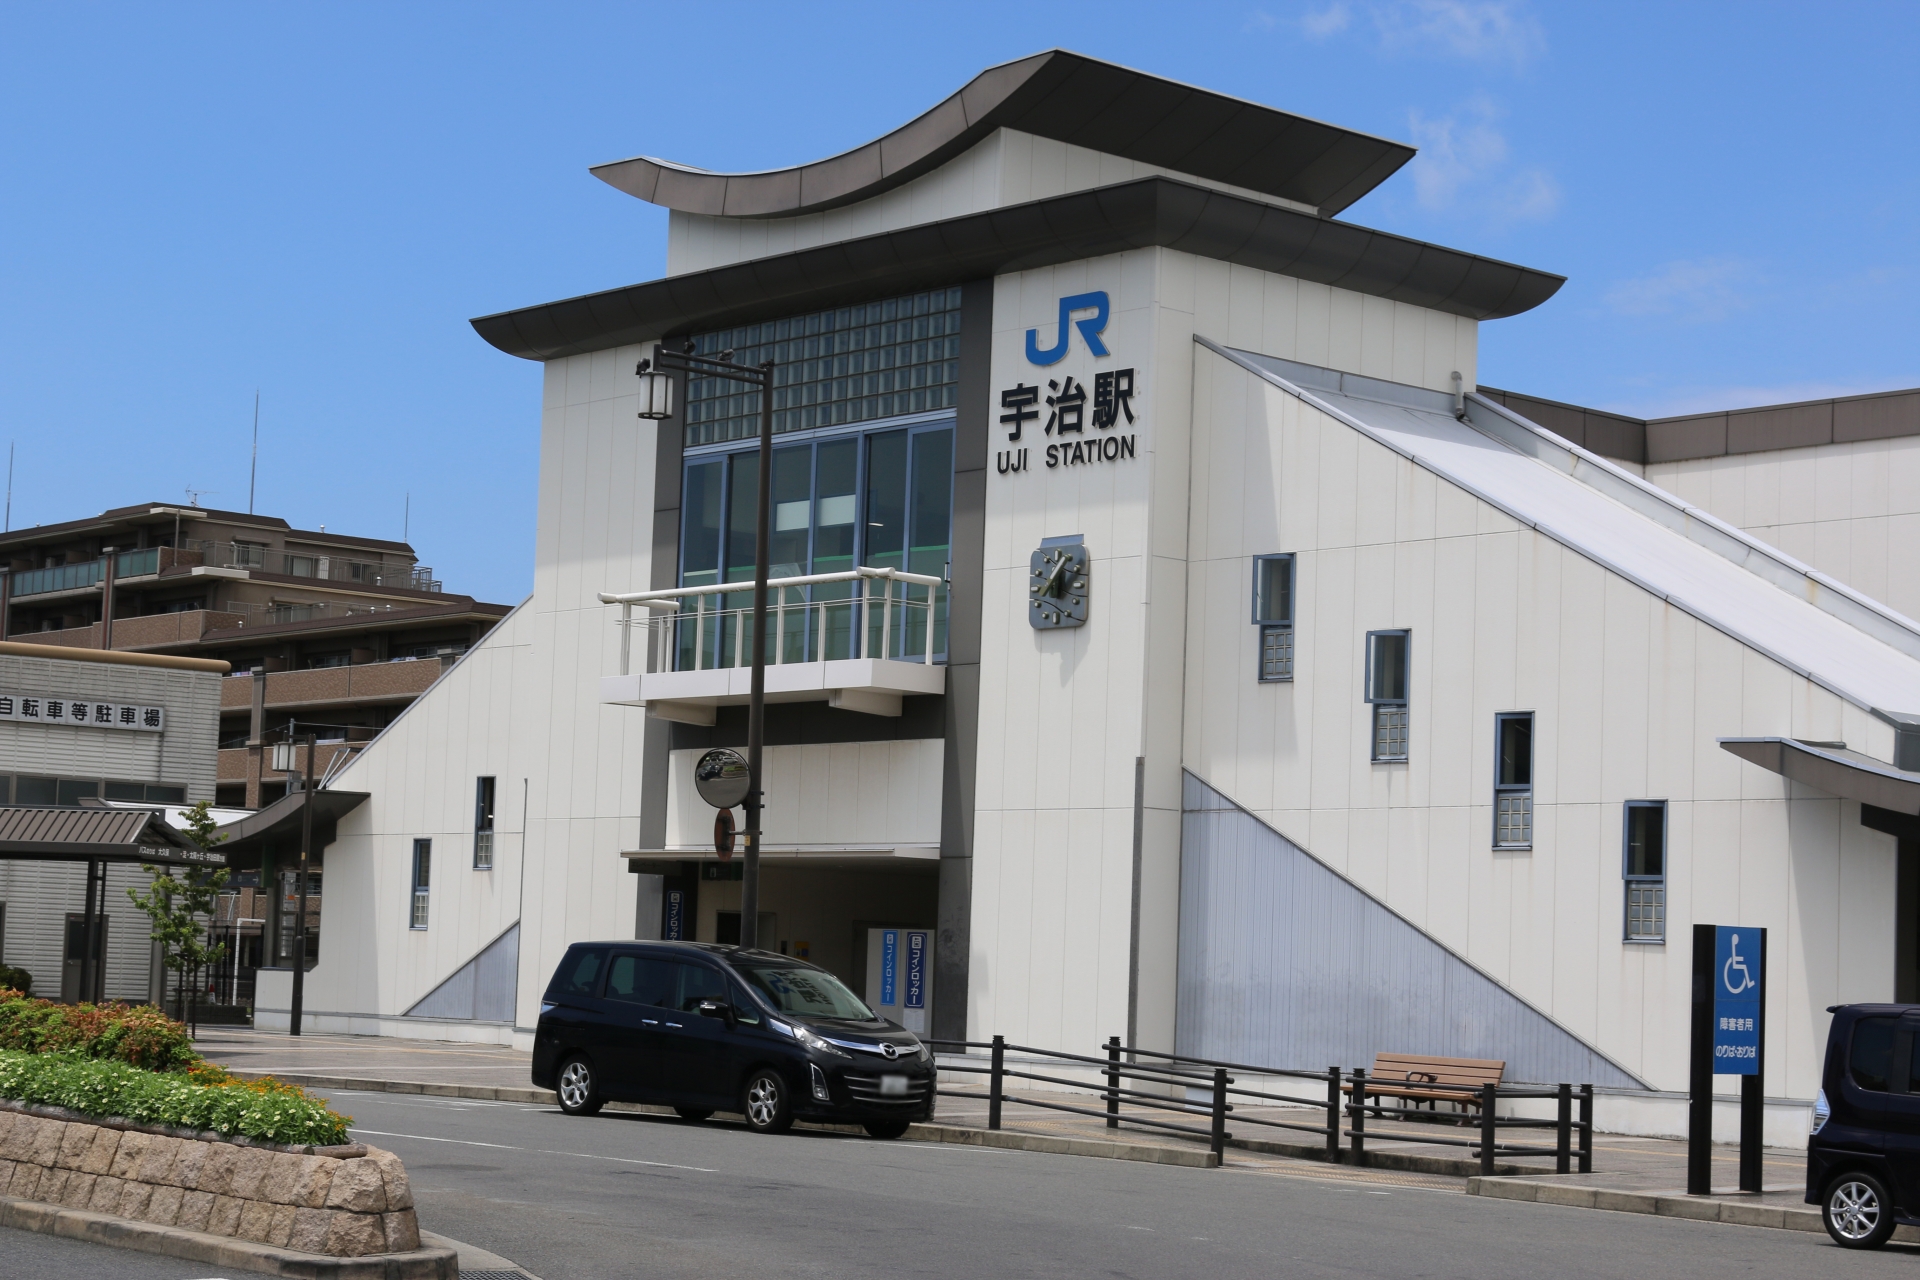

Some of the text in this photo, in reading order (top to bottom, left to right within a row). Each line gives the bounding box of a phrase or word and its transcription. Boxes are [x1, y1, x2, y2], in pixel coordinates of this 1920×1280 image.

[1025, 290, 1110, 366] JR
[999, 367, 1136, 442] 宇治駅
[997, 433, 1137, 475] UJI STATION
[0, 696, 161, 728] 自転車等駐車場
[668, 903, 680, 941] コインロッカ
[885, 945, 893, 1002] コインロッカー
[910, 949, 920, 1005] コインロッカー
[1719, 1017, 1754, 1031] 障害者用
